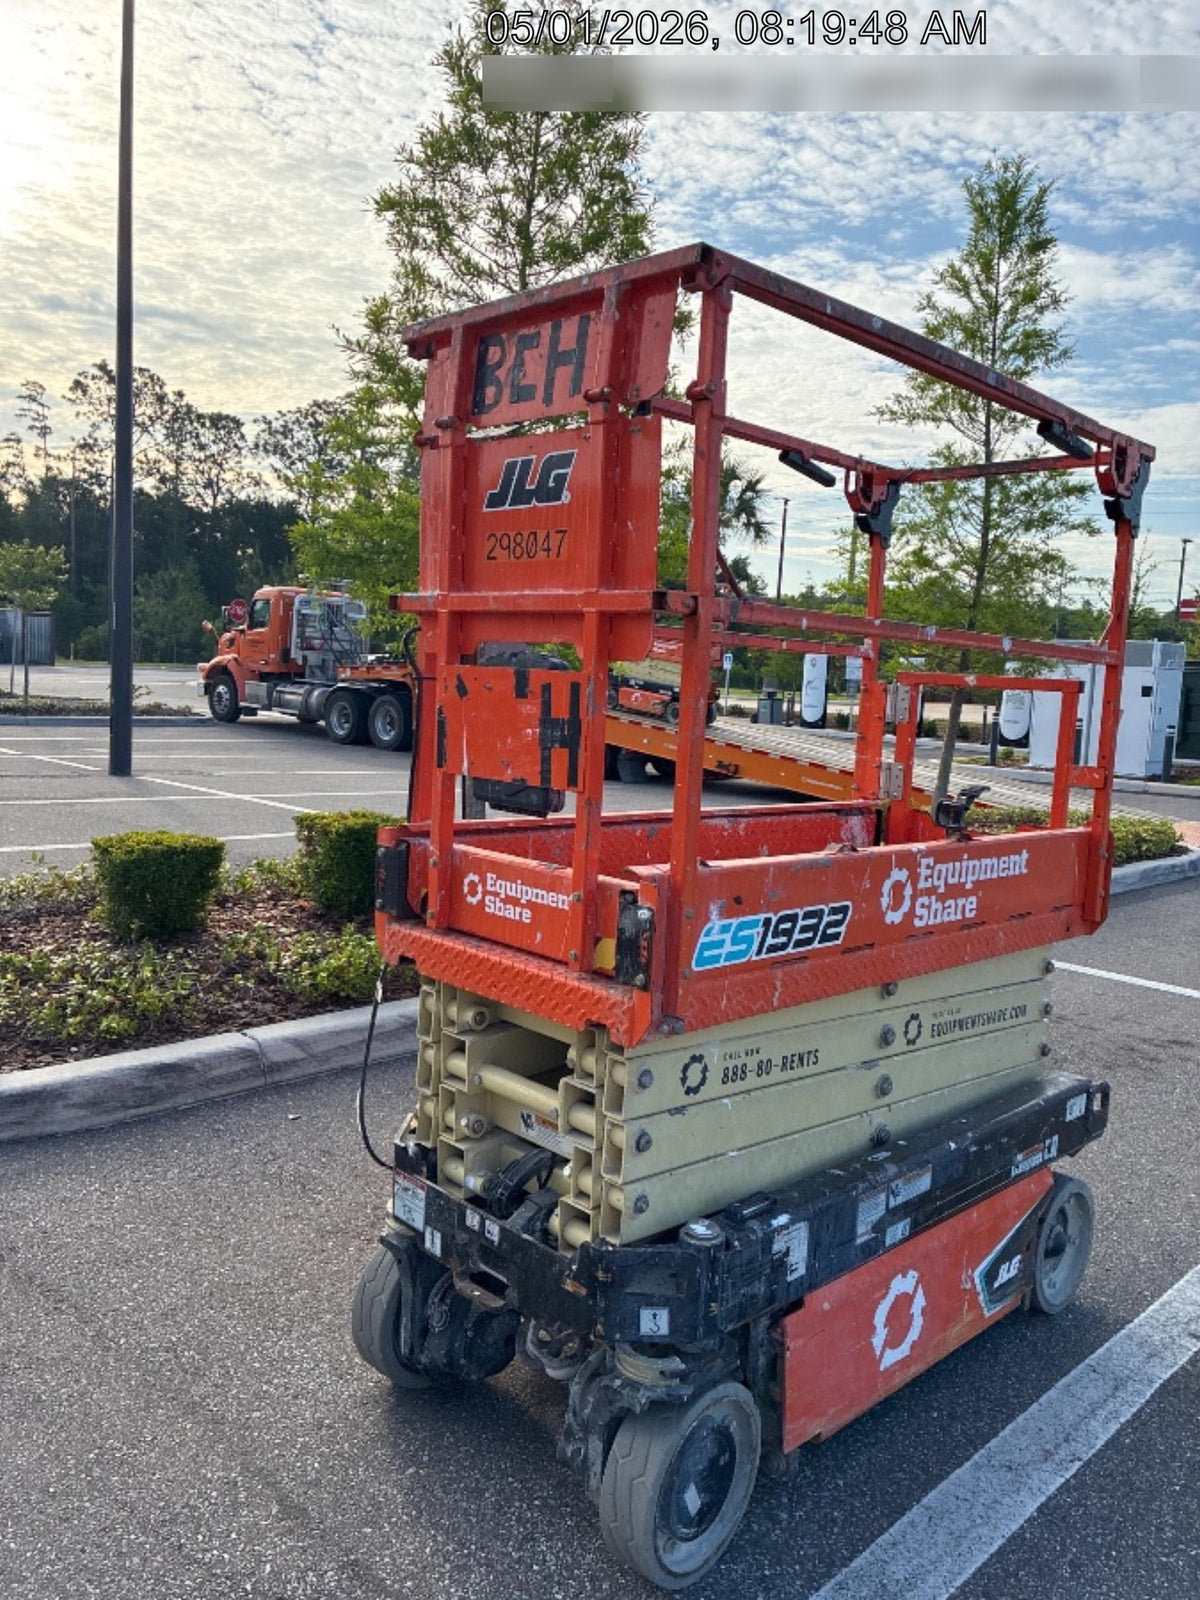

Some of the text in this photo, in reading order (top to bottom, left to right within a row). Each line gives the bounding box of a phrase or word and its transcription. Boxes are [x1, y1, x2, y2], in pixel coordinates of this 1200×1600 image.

[471, 314, 592, 416] BEH
[483, 449, 578, 512] JLG
[486, 529, 567, 560] 298047
[917, 849, 1029, 893] Equipment
[484, 895, 531, 923] Share
[486, 872, 573, 911] Equipmen
[913, 895, 977, 927] Share
[692, 901, 852, 971] ES1932
[721, 1048, 820, 1085] 888-80-RENTS
[993, 1254, 1021, 1288] JLG
